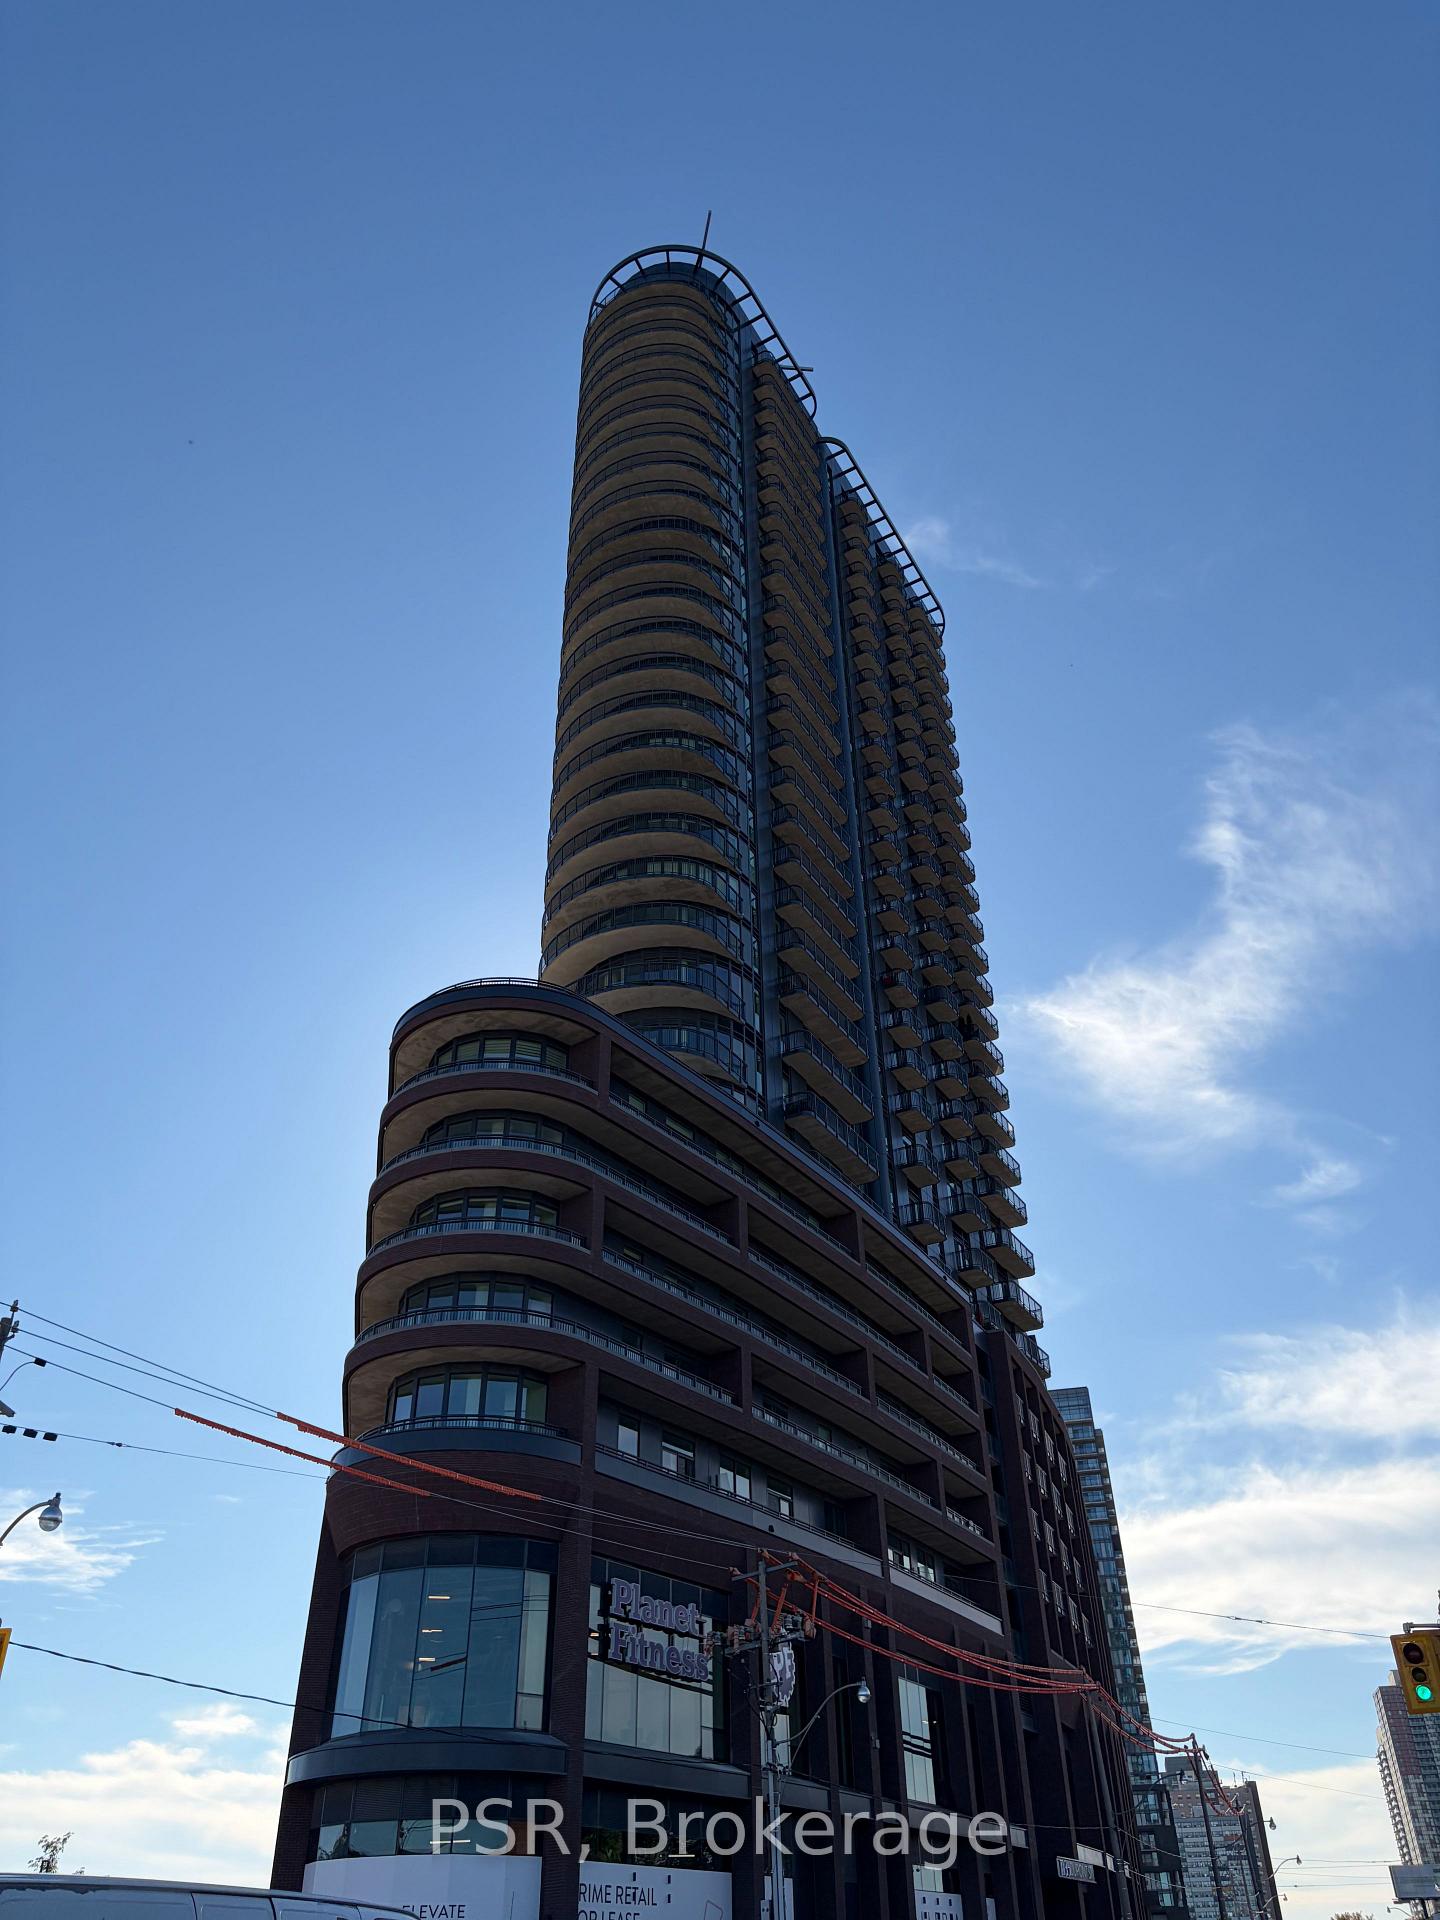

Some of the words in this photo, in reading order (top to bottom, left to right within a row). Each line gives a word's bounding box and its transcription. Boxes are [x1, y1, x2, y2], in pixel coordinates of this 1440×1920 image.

[610, 1577, 701, 1637] Planet
[608, 1621, 709, 1681] Fitness
[578, 1882, 612, 1904] RIME
[615, 1885, 658, 1906] RETAIL
